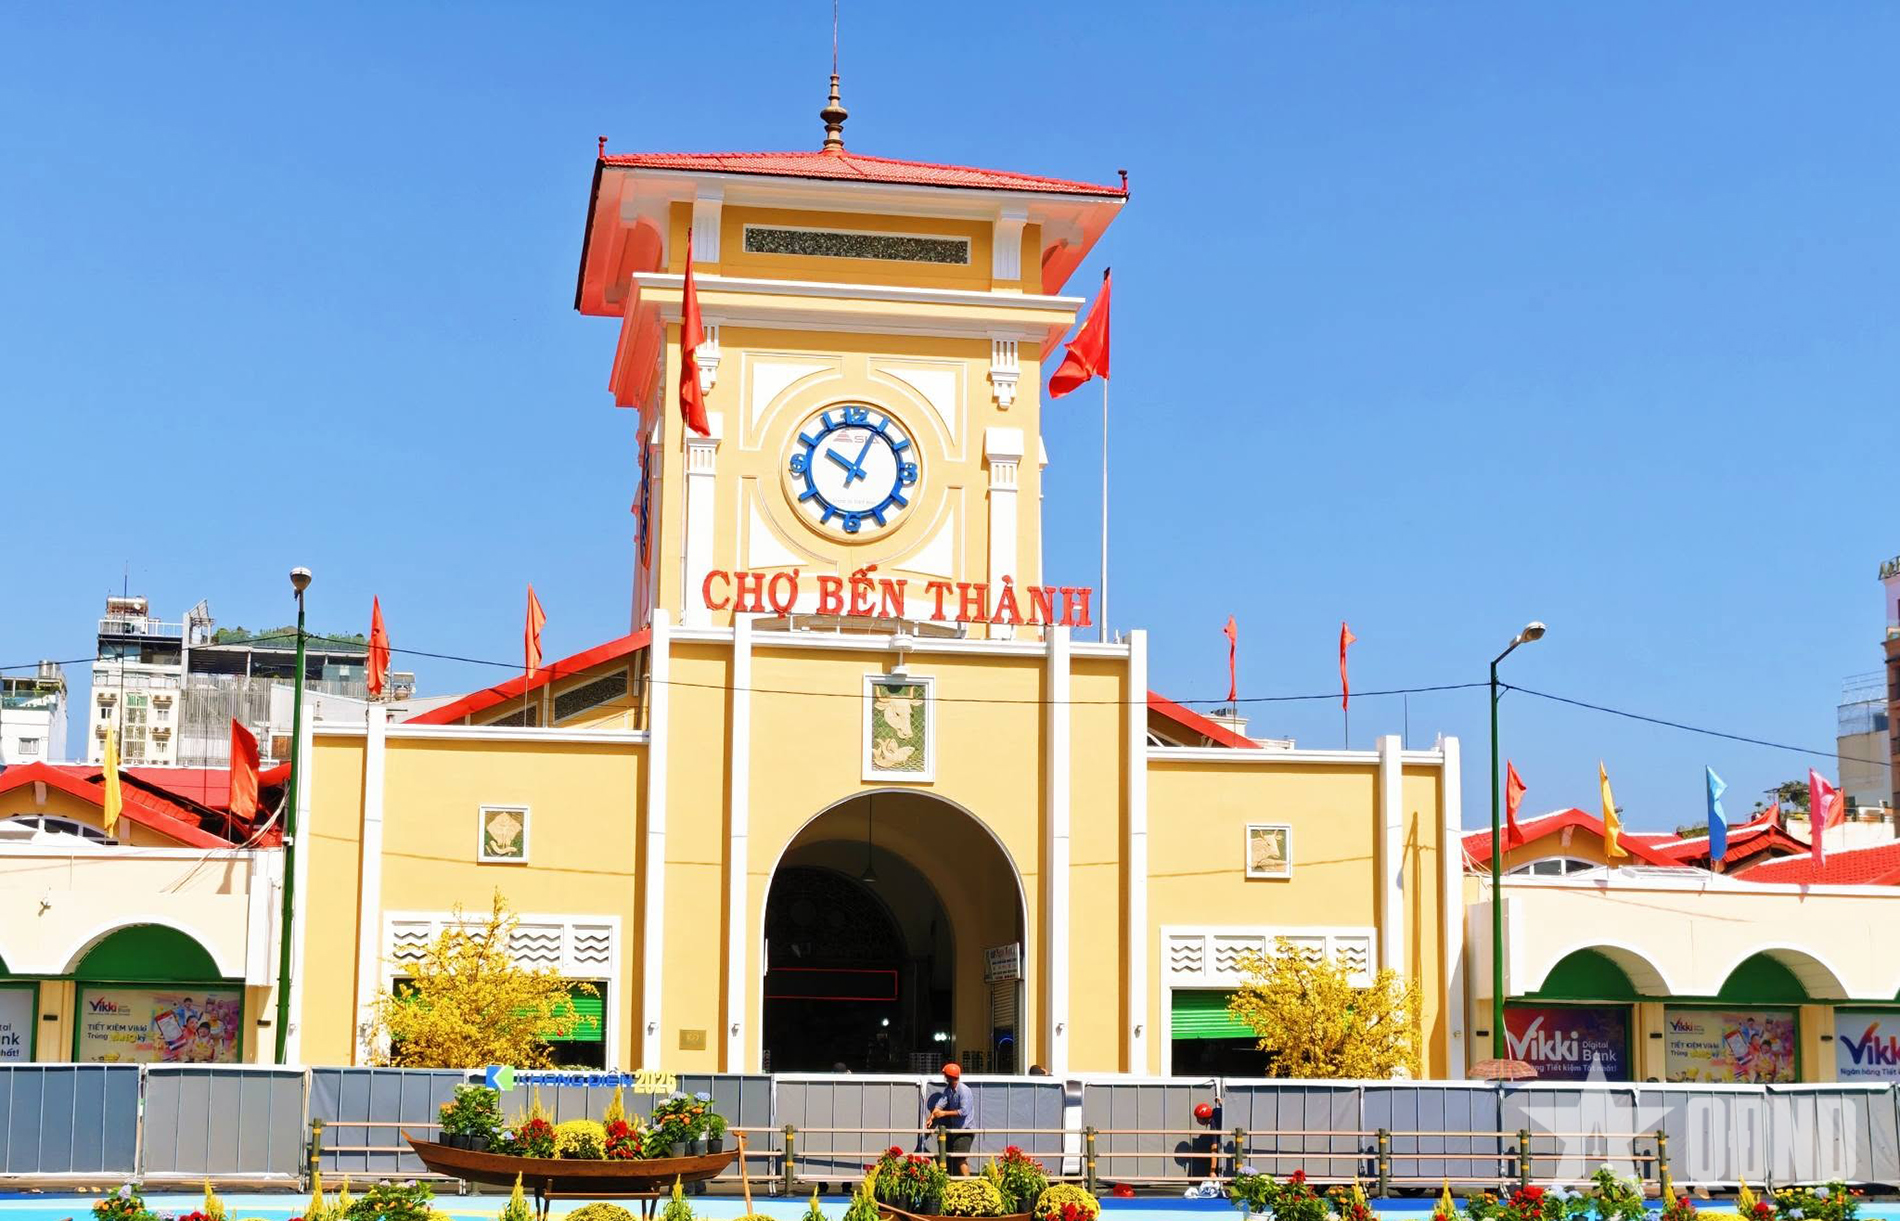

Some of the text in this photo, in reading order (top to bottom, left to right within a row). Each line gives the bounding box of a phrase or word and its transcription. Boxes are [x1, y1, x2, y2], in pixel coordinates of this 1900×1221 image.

[842, 405, 868, 425] 12
[790, 453, 806, 474] 9
[901, 462, 918, 483] 3
[844, 513, 861, 533] 6
[702, 564, 1092, 627] CHỢ BẾN THÀNH
[89, 997, 117, 1012] Vikki
[1503, 1016, 1579, 1061] Vikki
[1582, 1041, 1609, 1050] Digital
[1582, 1049, 1617, 1062] Bank
[517, 1073, 584, 1087] KHANG
[634, 1069, 676, 1094] 2026
